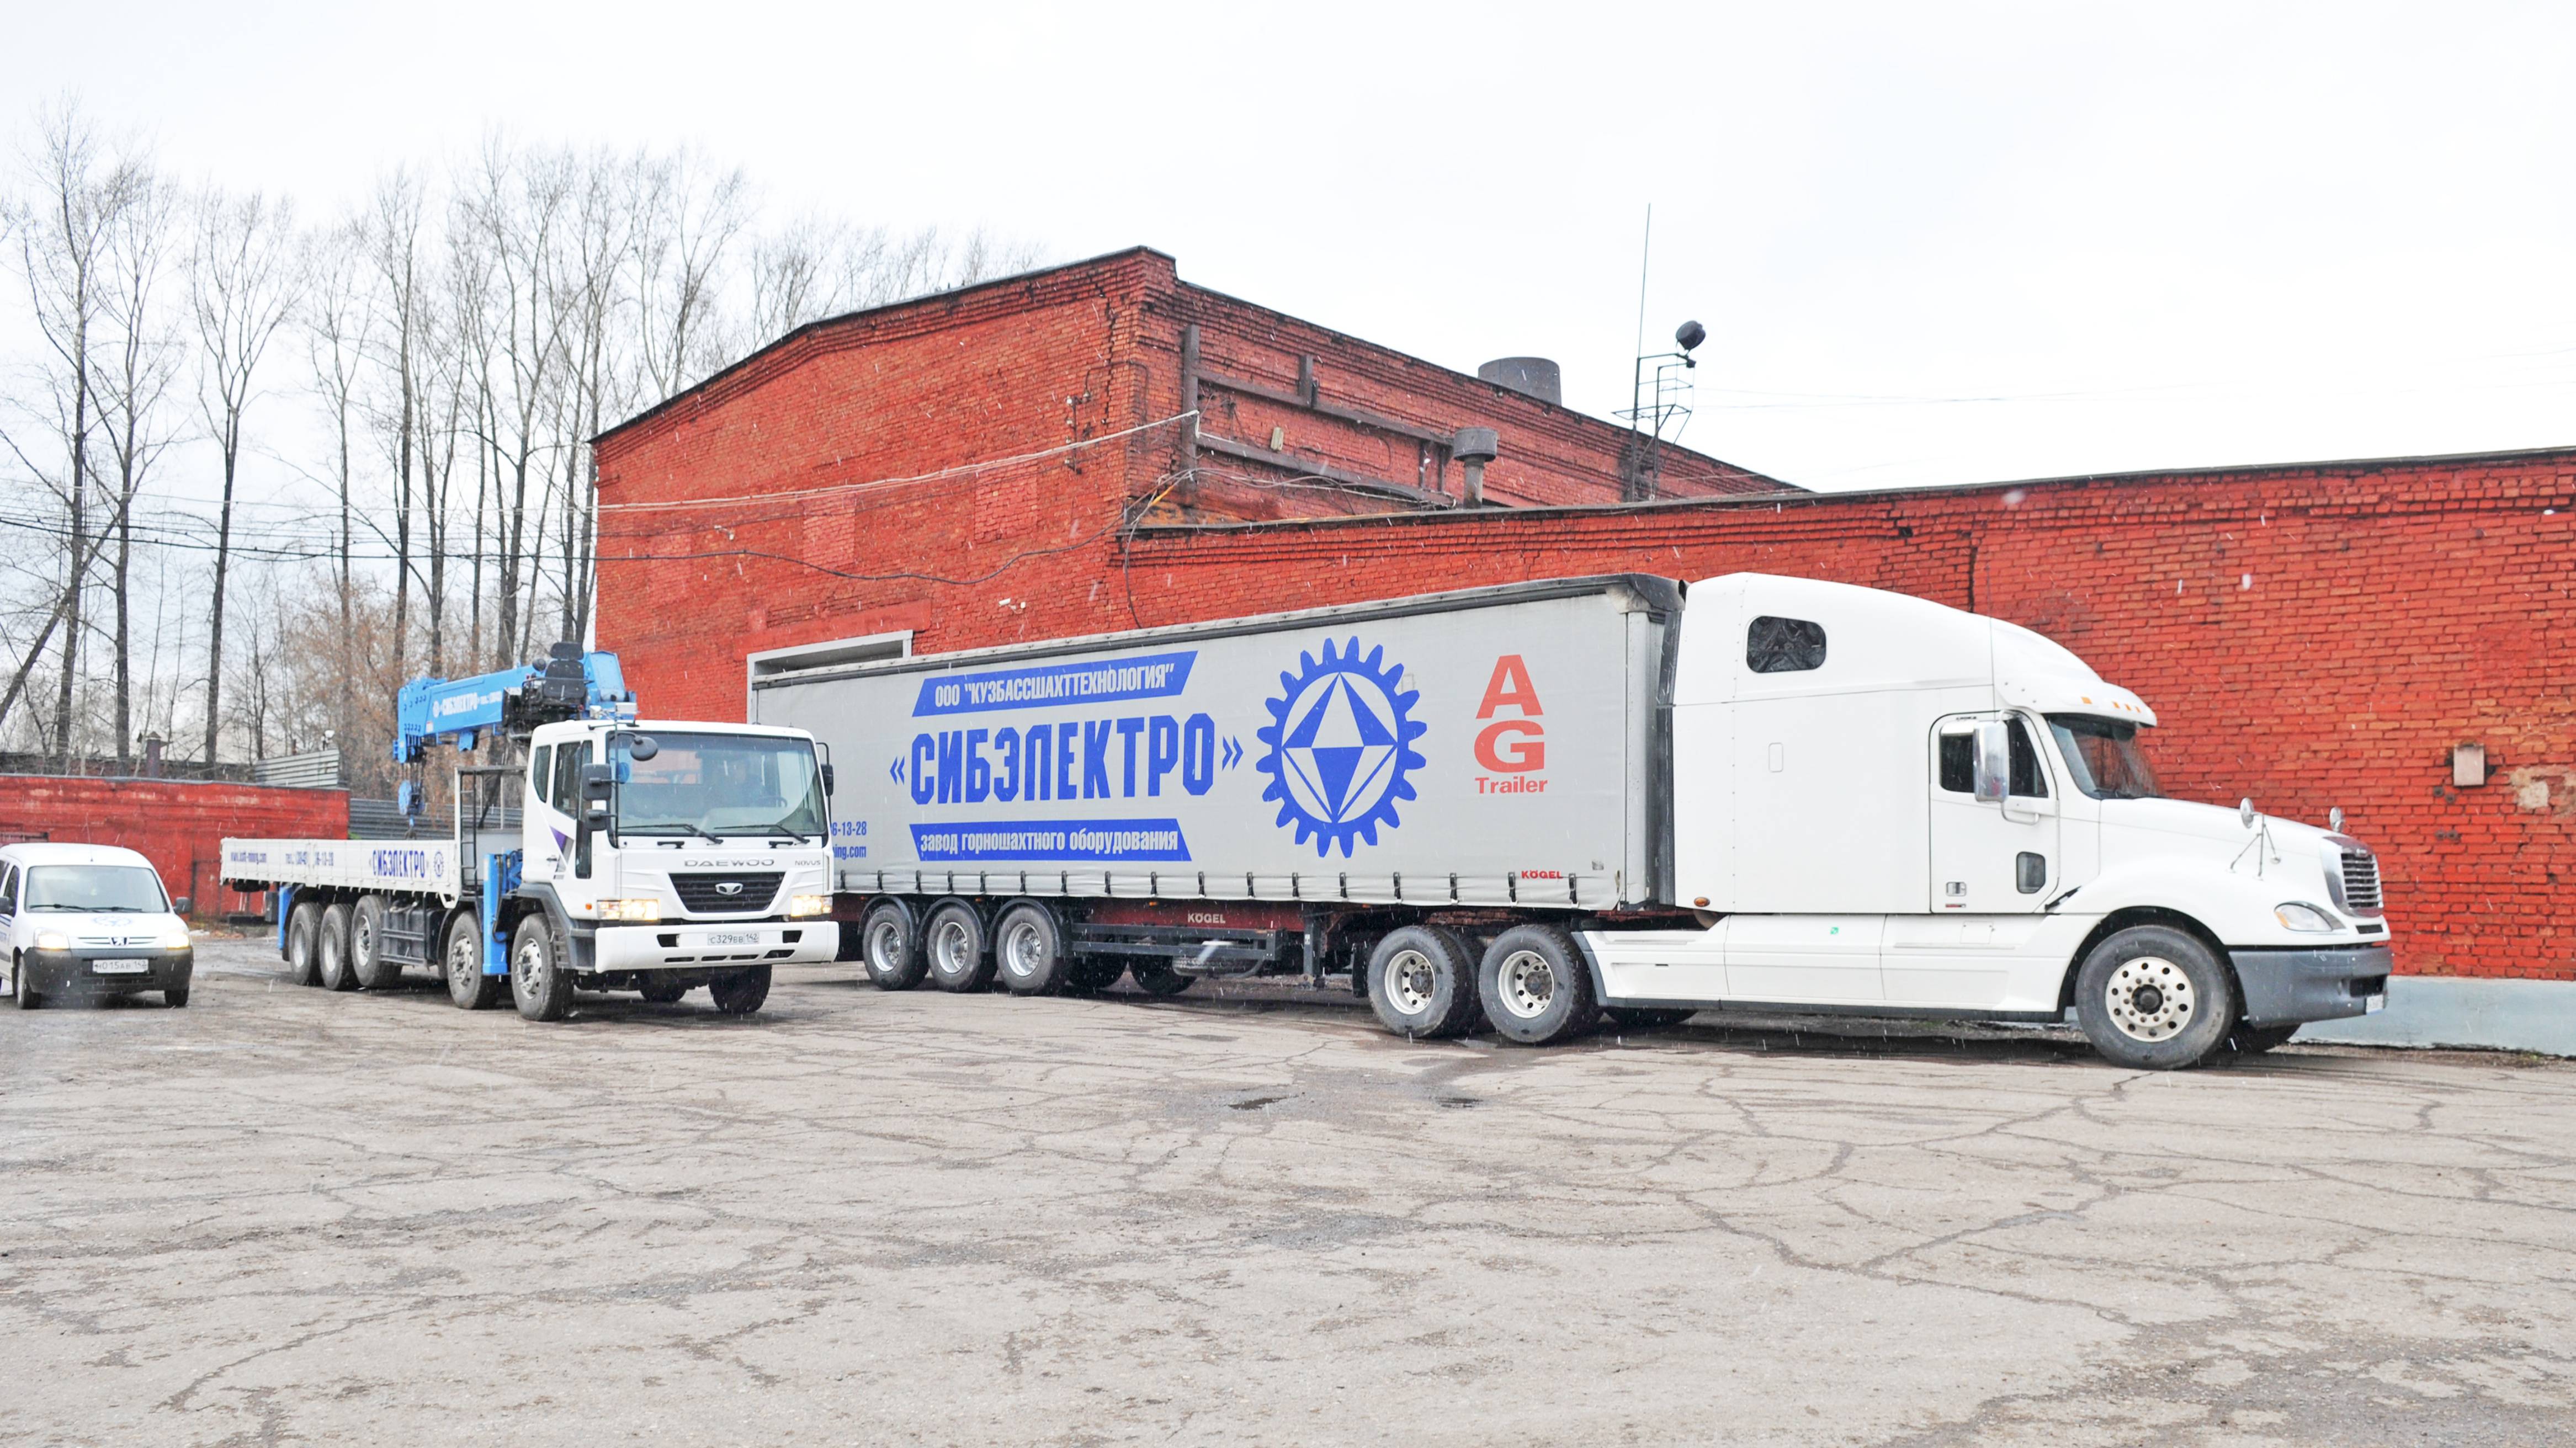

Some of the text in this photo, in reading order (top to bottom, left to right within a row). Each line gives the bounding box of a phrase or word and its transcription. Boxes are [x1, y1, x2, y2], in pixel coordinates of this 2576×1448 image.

[935, 663, 1175, 707] ООО "КУЗБАССШАХТТЕХНОЛОГИЯ"
[1475, 654, 1543, 719] A
[890, 713, 1244, 805] «СИБЭЛЕКТРО»
[1474, 720, 1545, 773] G
[1475, 776, 1548, 794] Trailer
[920, 828, 1178, 855] завод горношахтного оборудования
[1521, 870, 1563, 880] KÖGEL
[1187, 912, 1226, 924] KÖGEL
